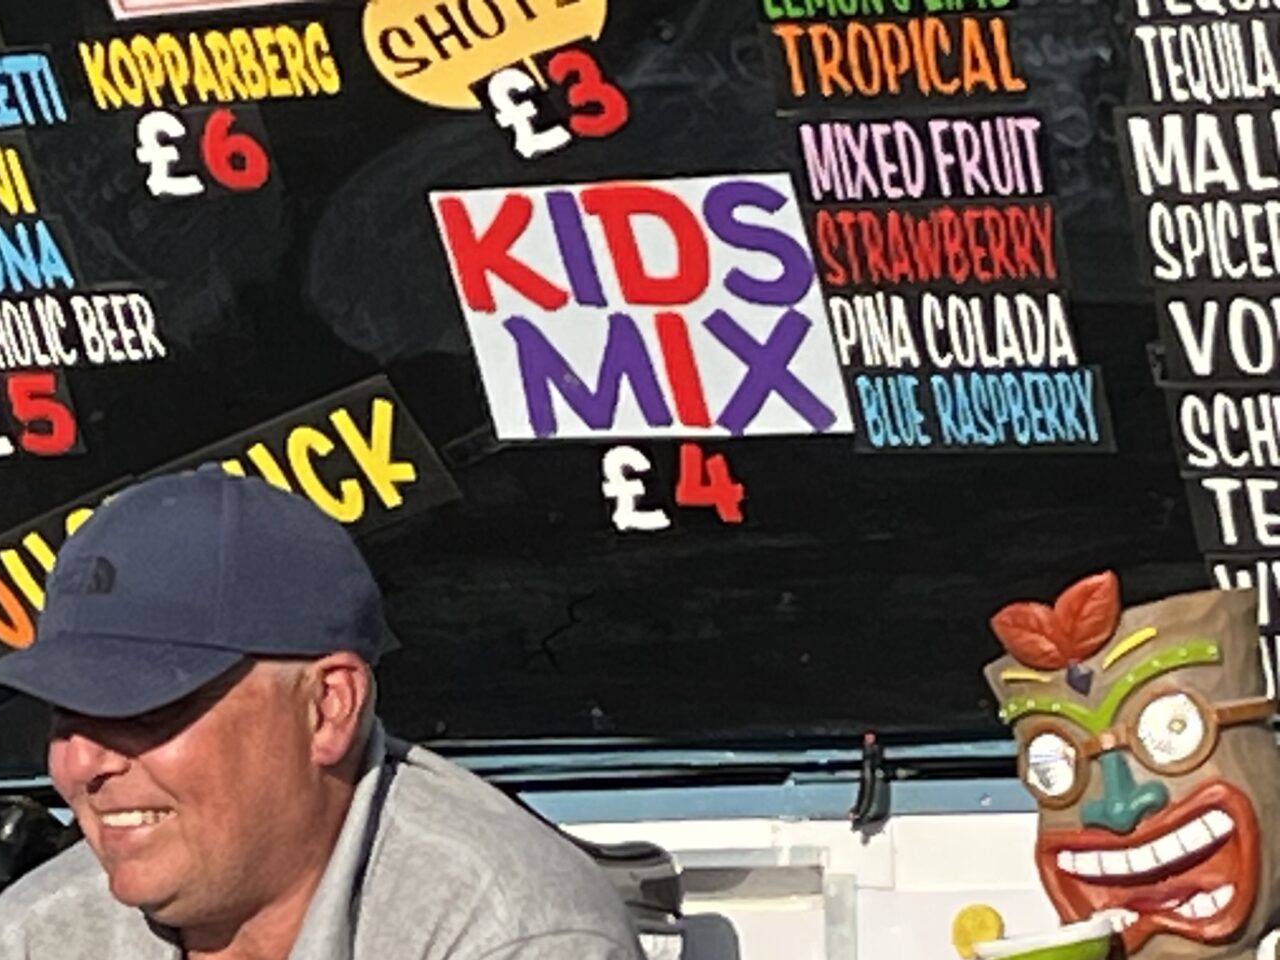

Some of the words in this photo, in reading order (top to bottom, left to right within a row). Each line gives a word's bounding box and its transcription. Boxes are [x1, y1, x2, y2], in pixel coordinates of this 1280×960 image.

[78, 22, 341, 110] KOPPARBERG
[772, 17, 1027, 97] TROPICAL
[1135, 19, 1280, 105] TEQUILA
[488, 47, 629, 159] £3
[135, 107, 270, 196] £6
[799, 120, 926, 201] MIXED
[928, 116, 1044, 197] FRUIT
[437, 180, 816, 313] KIDS
[817, 203, 1058, 285] STRAWBERRY
[70, 293, 166, 364] BEER
[829, 292, 920, 367] PINA
[922, 293, 1079, 368] COLADA
[502, 308, 837, 436] MIX
[855, 373, 931, 448] BLUE
[930, 369, 1099, 446] RASPBERRY
[602, 443, 744, 531] £4
